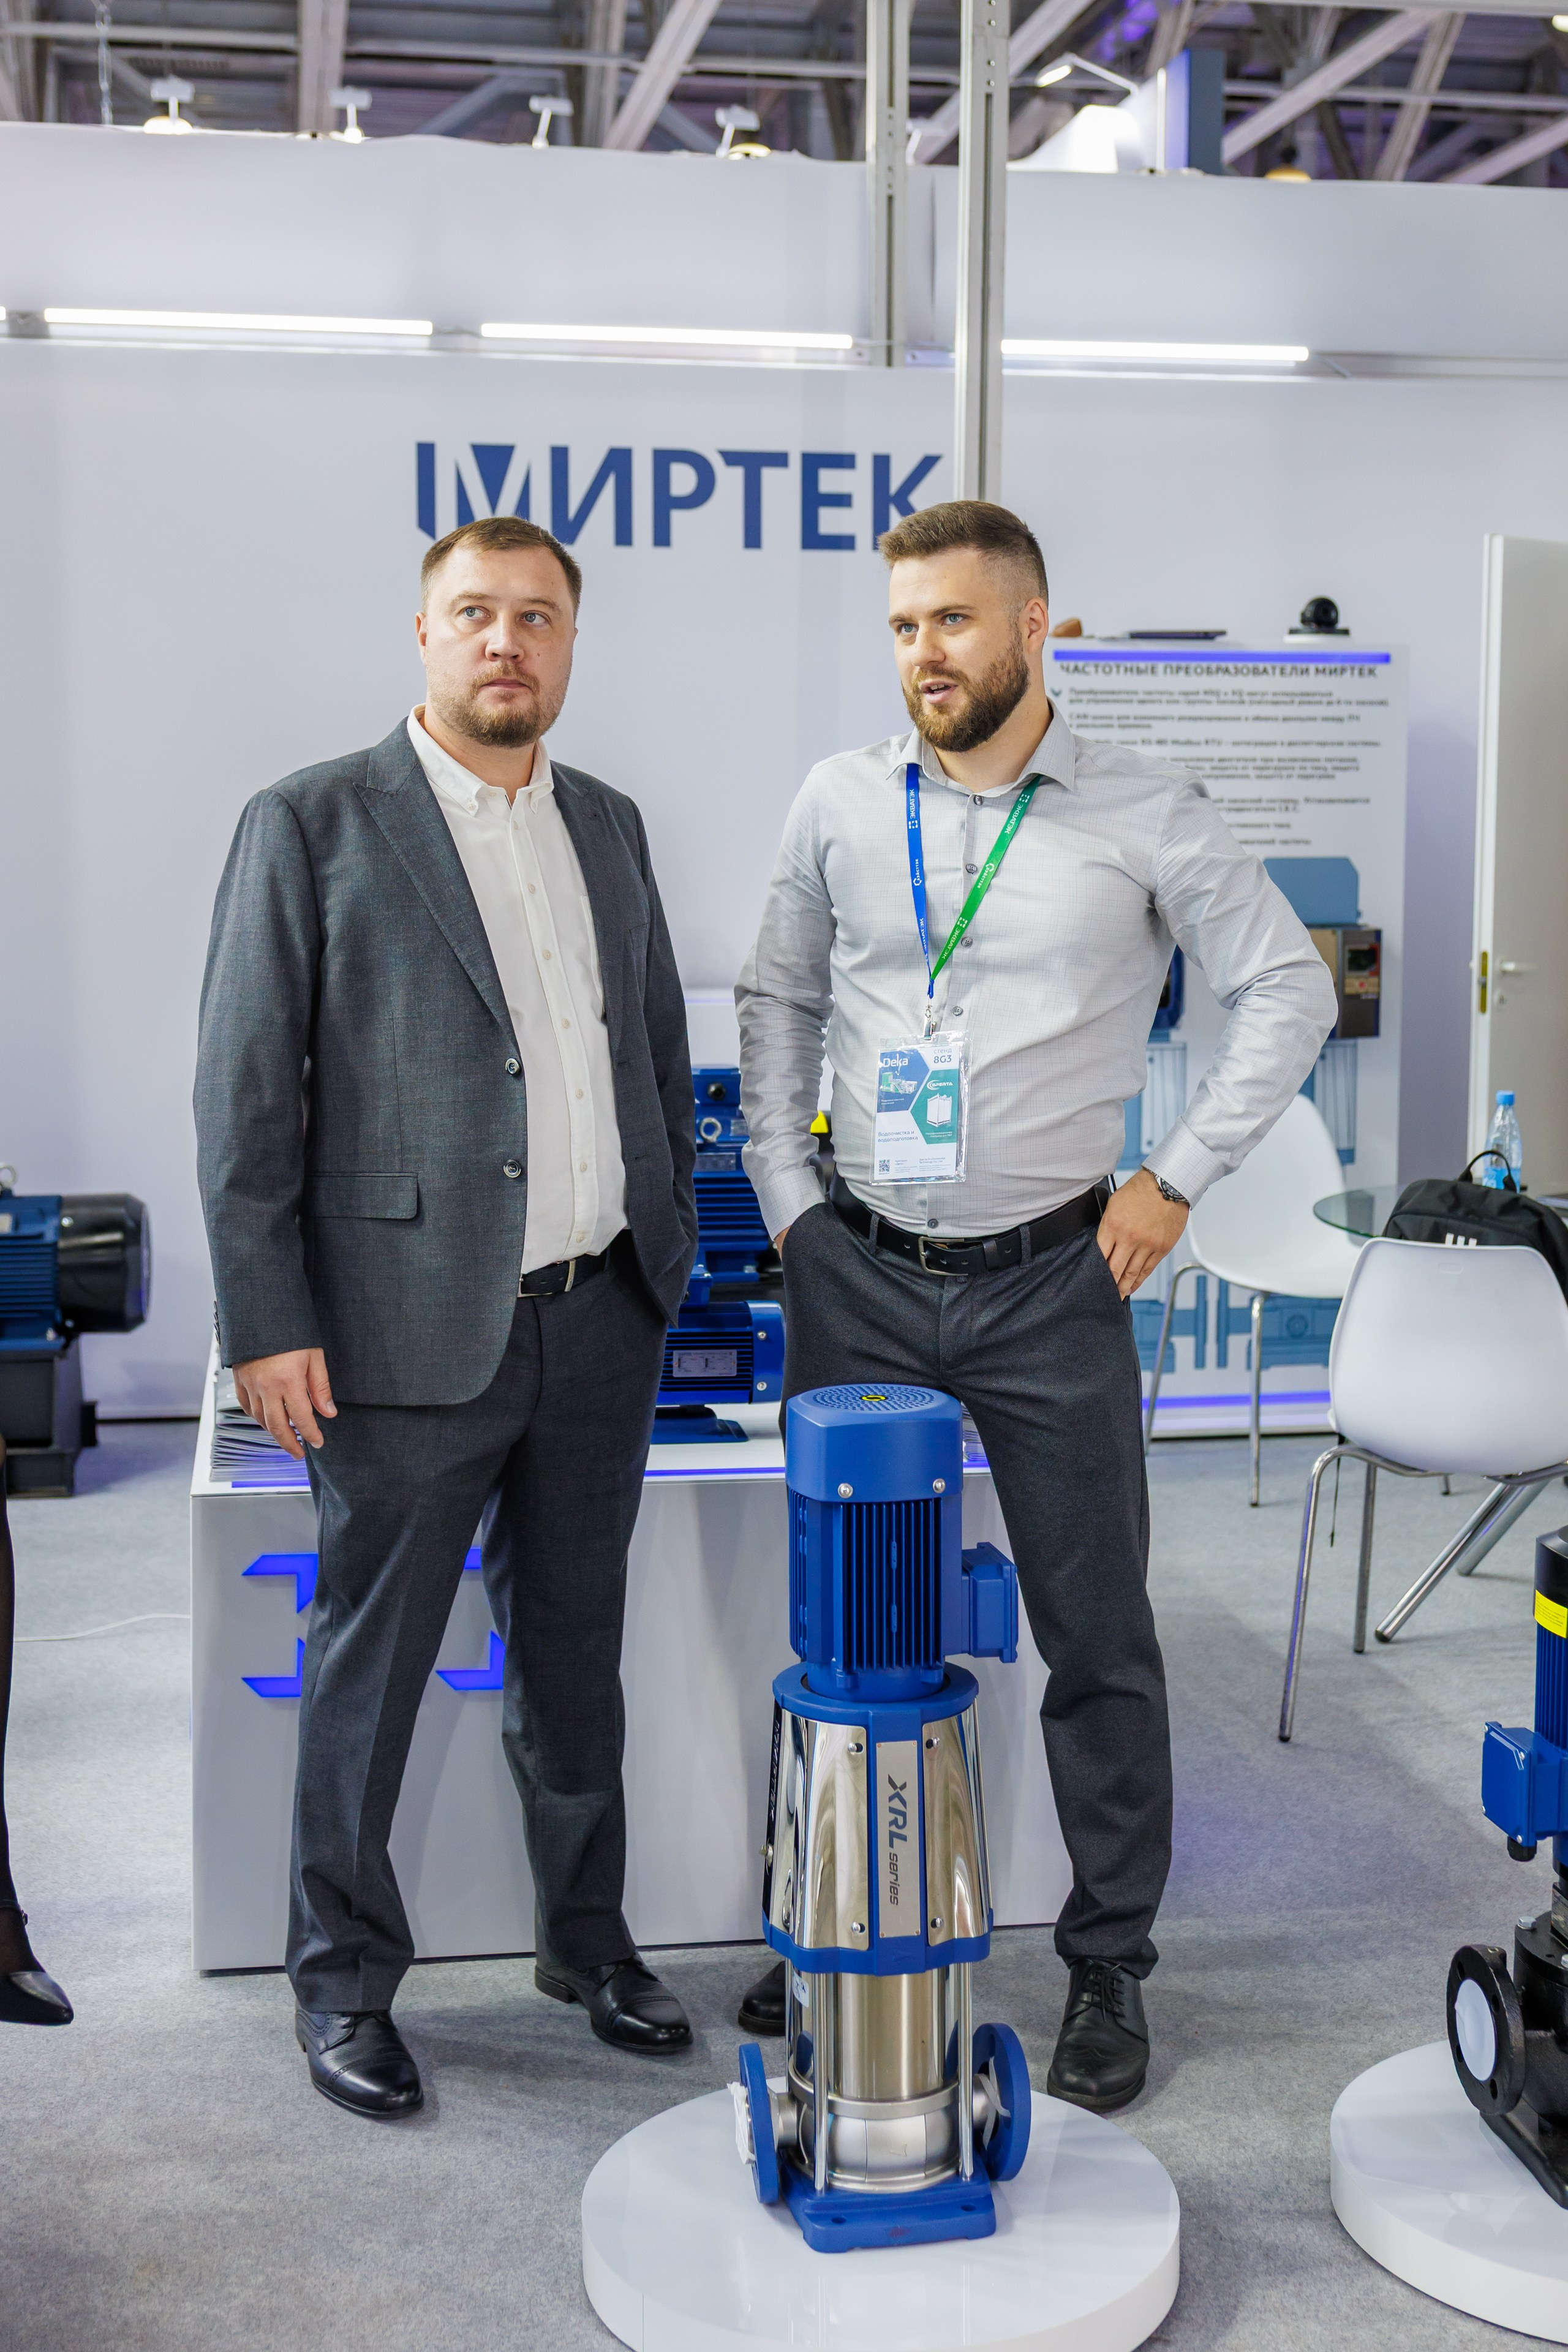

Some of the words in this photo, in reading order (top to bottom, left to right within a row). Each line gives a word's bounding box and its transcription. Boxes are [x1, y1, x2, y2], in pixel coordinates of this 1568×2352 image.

[1060, 663, 1158, 676] ЧАСТОТНЫЕ
[1164, 663, 1310, 677] ПРЕОБРАЗОВАТЕЛИ
[1314, 665, 1378, 677] МИРТЕК
[1004, 803, 1023, 835] ЭКВАТЭК
[942, 927, 961, 959] ЭКВАТЭК
[933, 1055, 952, 1064] 8G3
[888, 1773, 908, 1849] XRL
[889, 1852, 900, 1905] series
